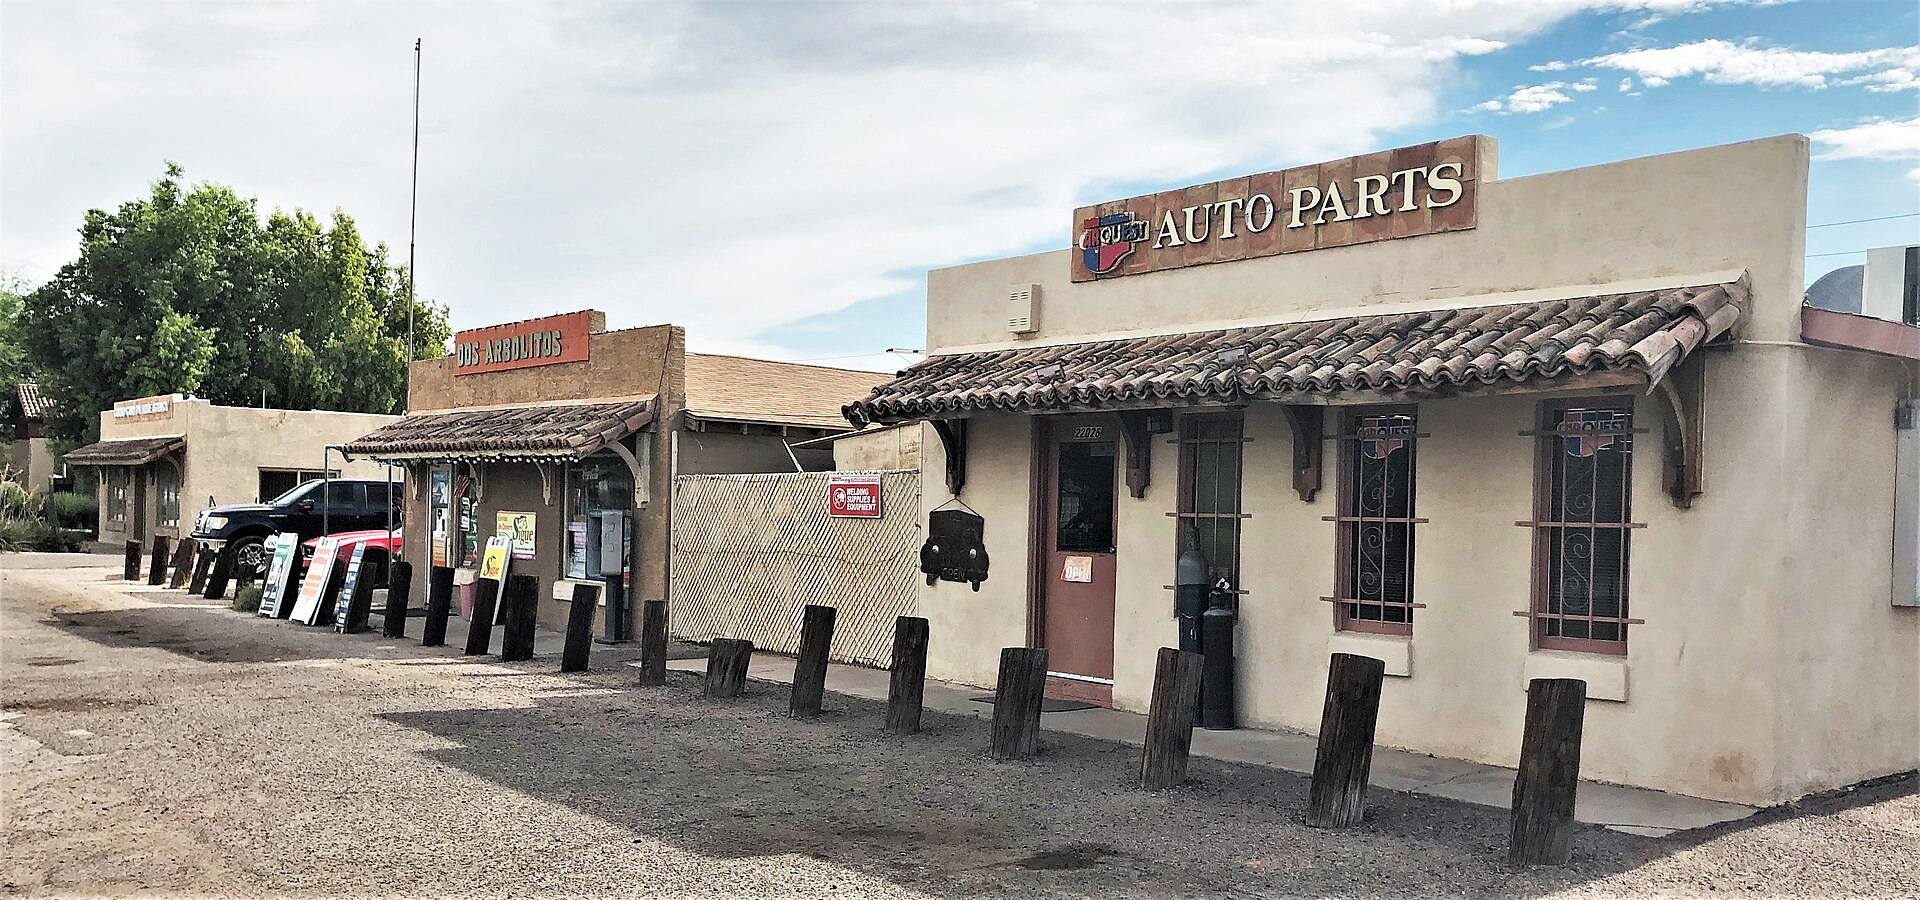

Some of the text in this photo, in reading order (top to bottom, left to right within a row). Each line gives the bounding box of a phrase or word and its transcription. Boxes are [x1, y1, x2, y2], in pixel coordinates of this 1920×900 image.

[1152, 193, 1274, 249] AUTO
[1287, 162, 1464, 229] PARTS
[457, 329, 562, 368] DOS ARBOLITOS
[1074, 426, 1102, 440] 22026
[846, 487, 869, 496] WELDING
[846, 495, 876, 504] SUPPLIES &
[846, 503, 877, 511] EQUIPMENT
